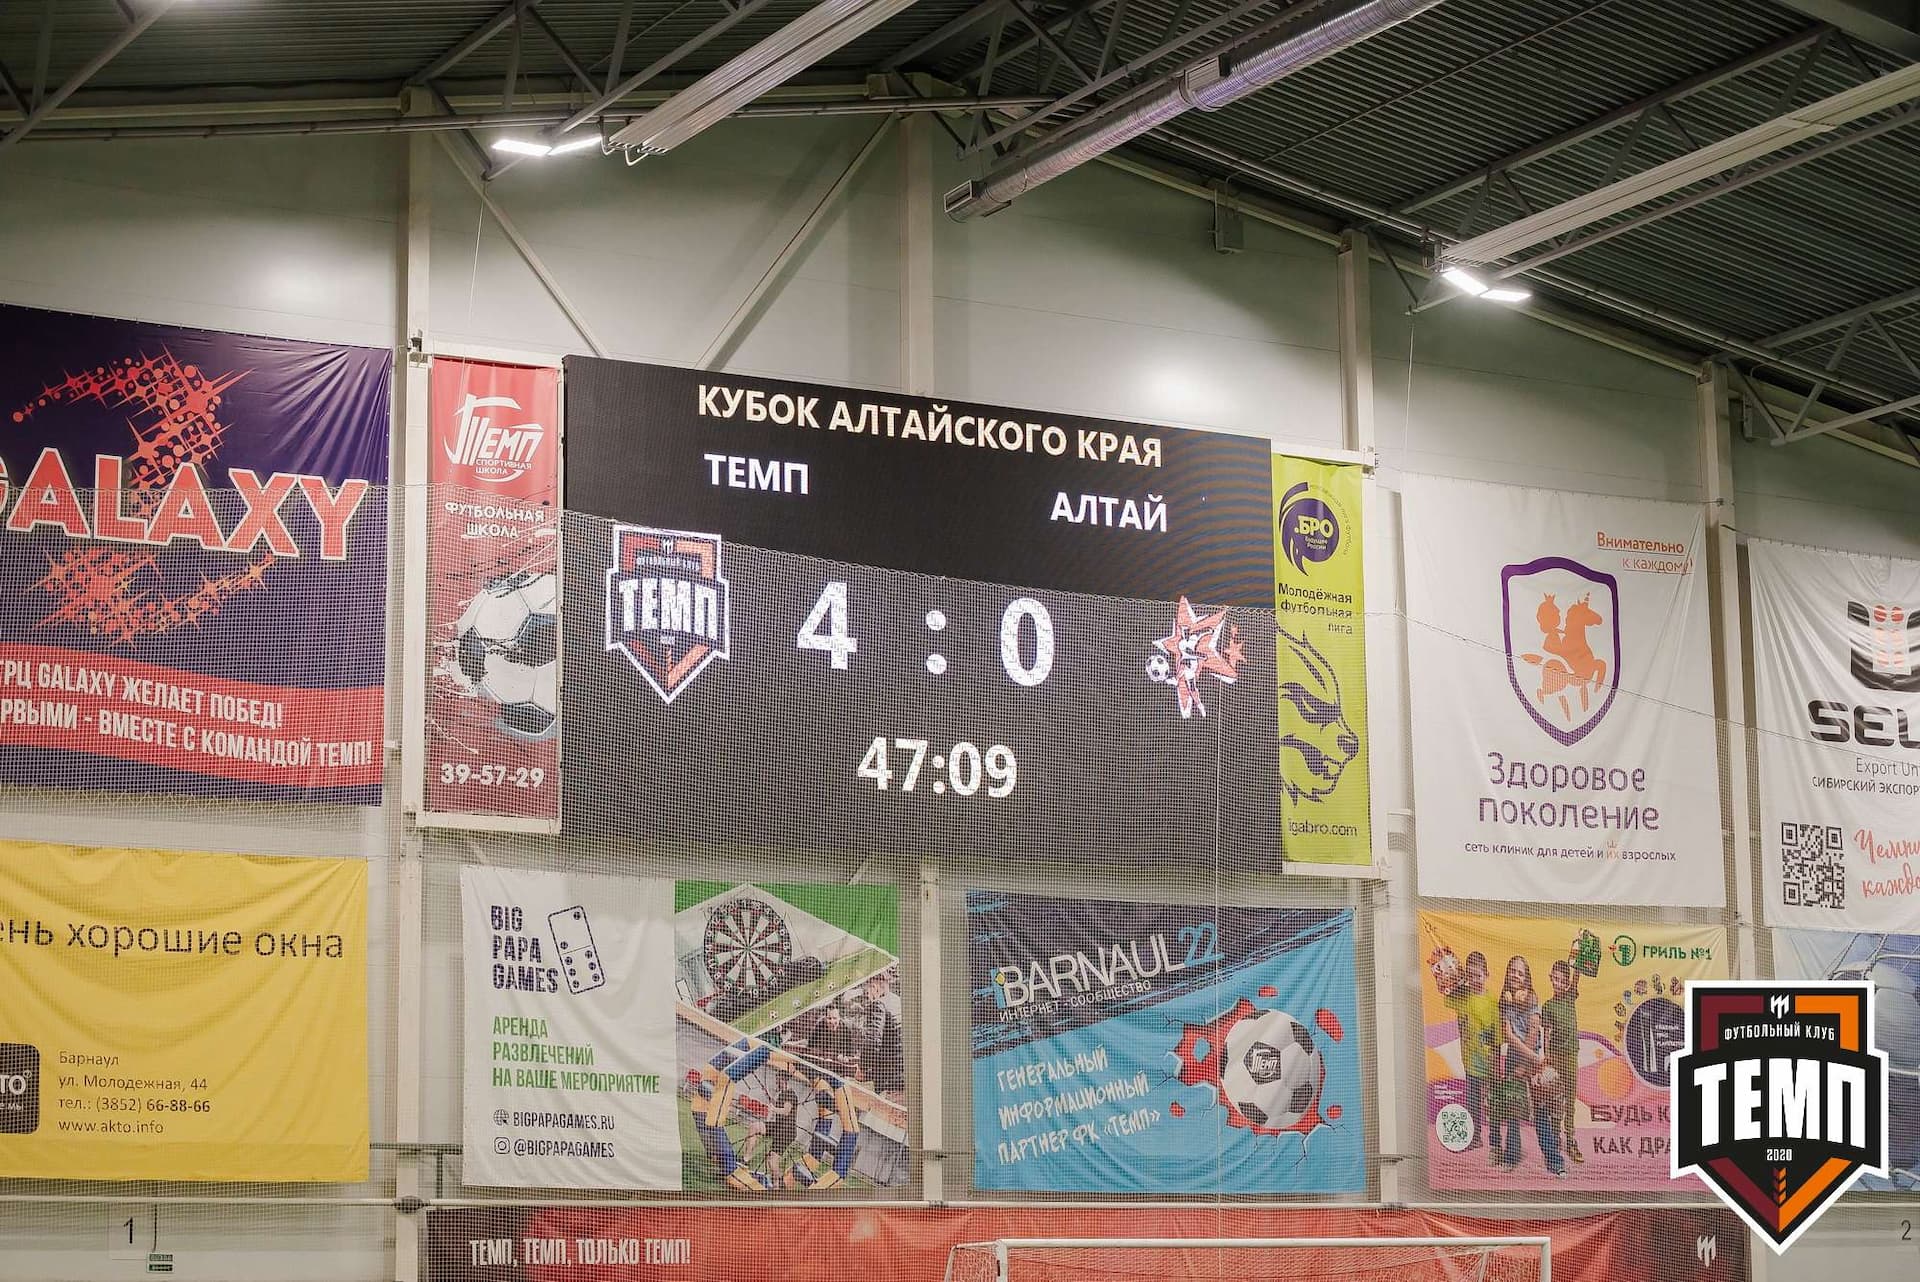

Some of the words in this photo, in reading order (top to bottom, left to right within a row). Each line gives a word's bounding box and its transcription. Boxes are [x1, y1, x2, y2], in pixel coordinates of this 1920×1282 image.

[443, 393, 544, 466] ТЕМП
[698, 384, 820, 429] КУБОК
[828, 401, 1067, 456] АЛТАЙСКОГО
[1078, 429, 1162, 468] КРАЯ
[475, 458, 532, 470] СПОРТИВНАЯ
[475, 466, 508, 476] ШКОЛА
[704, 453, 809, 495] ТЕМП
[0, 447, 368, 560] ALAXY
[445, 500, 545, 523] ФУТБОЛЬНАЯ
[1050, 491, 1167, 532] АЛТАЙ
[466, 521, 519, 538] ШКОЛА
[1597, 531, 1684, 553] Внимательно
[1622, 558, 1631, 569] к
[1278, 583, 1352, 604] Молодёжная
[619, 578, 717, 640] ТЕМП
[1280, 599, 1352, 618] футбольная
[795, 582, 858, 671] 4
[1000, 597, 1055, 687] 0
[1328, 622, 1353, 635] лига
[38, 662, 116, 698] GALAXY
[121, 675, 204, 716] ЖЕЛАЕТ
[210, 693, 282, 729] ПОБЕД!
[99, 709, 177, 748] ВМЕСТЕ
[183, 726, 196, 751] С
[201, 729, 313, 768] КОМАНДОЙ
[316, 741, 374, 767] ТЕМП!
[440, 763, 545, 789] 39-57-29
[857, 736, 1017, 799] 47:09
[1487, 751, 1646, 792] Здоровое
[1856, 757, 1898, 777] Export
[1812, 775, 1876, 793] СИБИРСКИЙ
[1879, 782, 1920, 796] ЭКСПОР
[1479, 797, 1660, 831] поколение
[1465, 842, 1489, 854] сеть
[1493, 843, 1534, 856] клиник
[1537, 847, 1558, 859] для
[1561, 846, 1594, 859] детей
[1597, 851, 1604, 860] и
[1622, 851, 1677, 862] взрослых
[491, 905, 523, 932] BIG
[0, 918, 54, 946] нь
[67, 922, 242, 958] хорошие
[254, 931, 343, 958] окна
[492, 934, 542, 963] PAPA
[1643, 945, 1687, 959] ГРИЛЬ
[1690, 947, 1712, 960] №1
[493, 963, 559, 993] GAMES
[999, 1001, 1060, 1023] ИНТЕРНЕТ
[1070, 979, 1151, 1008] СООБЩЕСТВО
[493, 1016, 549, 1039] АРЕНДА
[59, 1051, 119, 1068] Барнаул
[493, 1041, 594, 1066] РАЗВЛЕЧЕНИЙ
[997, 1043, 1109, 1092] ГЕНЕРАЛЬНЫЙ
[58, 1075, 79, 1091] ул.
[84, 1075, 186, 1093] Молодежная,
[190, 1078, 208, 1091] 44
[492, 1067, 512, 1087] НА
[516, 1068, 558, 1089] ВАШЕ
[560, 1071, 660, 1094] МЕРОПРИЯТИЕ
[58, 1099, 92, 1111] тел.:
[96, 1097, 143, 1114] (3852)
[146, 1100, 211, 1113] 66-88-66
[998, 1070, 1150, 1131] ИНФОРМАЦИОННЫЙ
[58, 1119, 164, 1134] www.akto.info
[513, 1111, 615, 1130] BIGPAPAGAMES.RU
[1591, 1104, 1653, 1126] БУДЬ
[513, 1138, 615, 1158] @BIGPAPAGAMES
[998, 1128, 1068, 1165] ПАРТНЕР
[1072, 1120, 1100, 1146] ФК
[1104, 1108, 1160, 1137] «ТЕМП»
[1593, 1136, 1633, 1154] КАК
[123, 1216, 133, 1244] 1
[1901, 1219, 1911, 1241] 2
[470, 1238, 518, 1267] ТЕМП,
[523, 1238, 571, 1267] ТЕМП,
[576, 1238, 640, 1265] ТОЛЬКО
[644, 1238, 691, 1265] ТЕМП!
